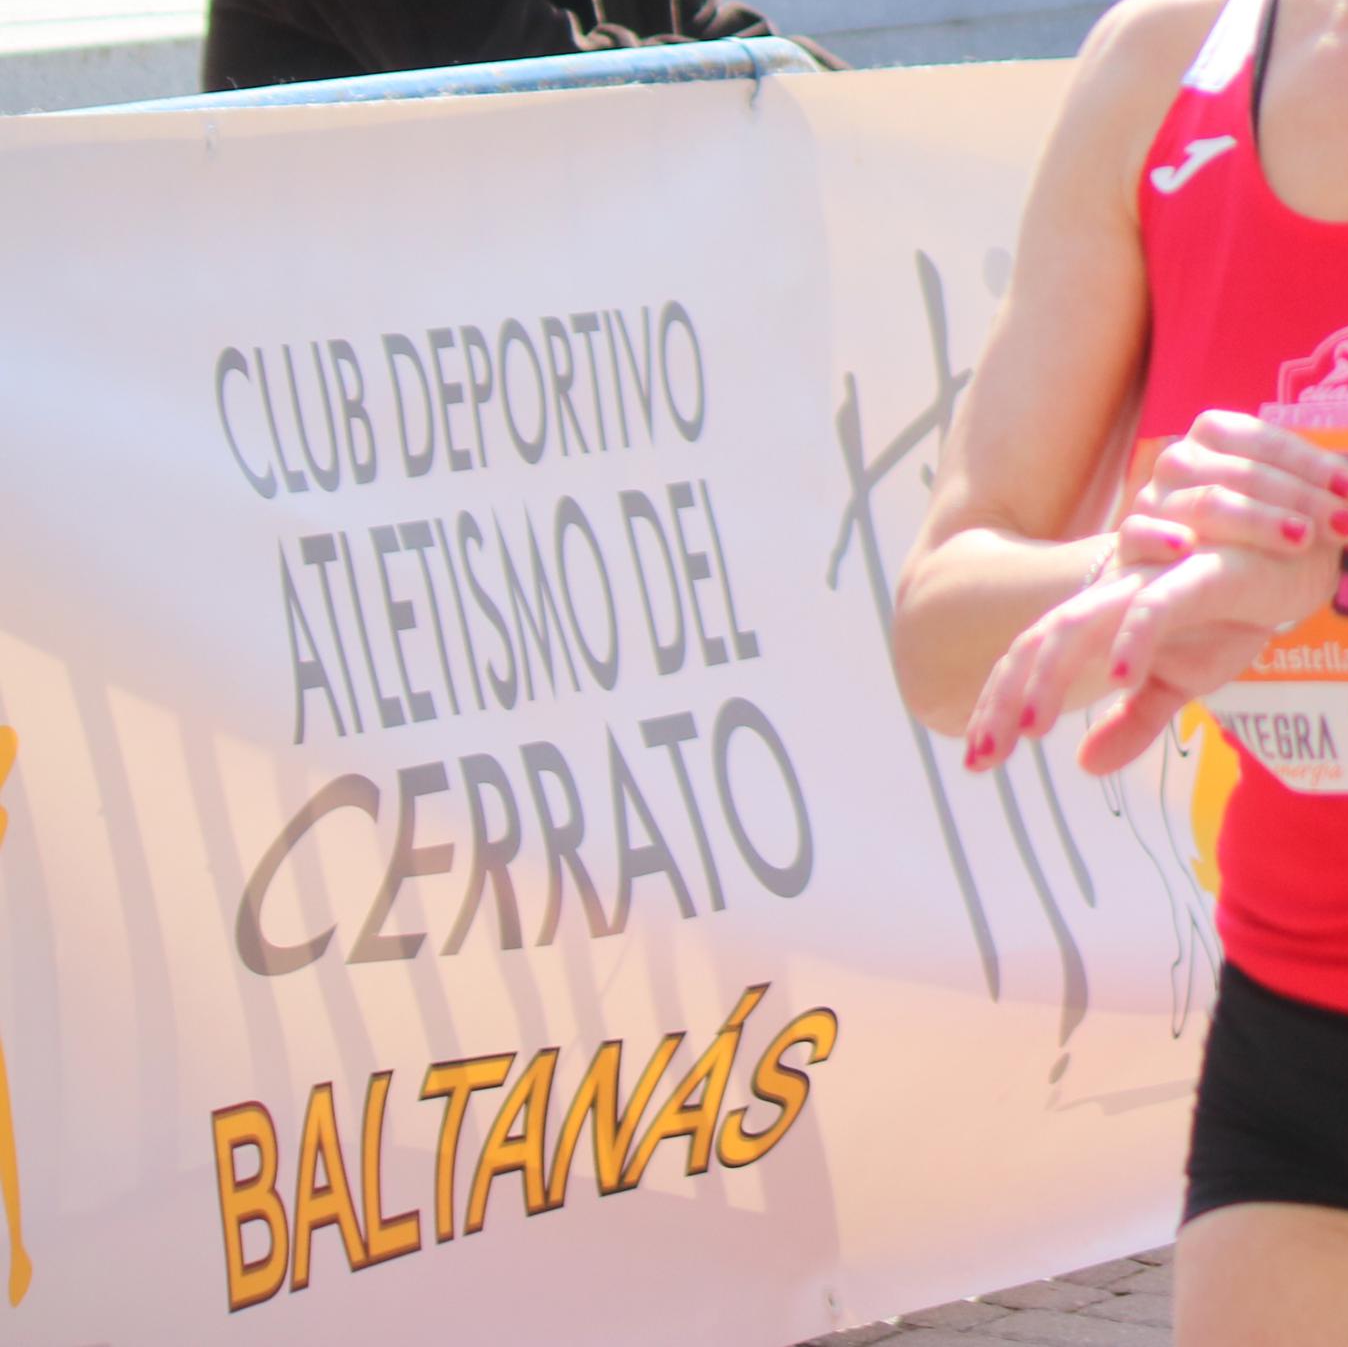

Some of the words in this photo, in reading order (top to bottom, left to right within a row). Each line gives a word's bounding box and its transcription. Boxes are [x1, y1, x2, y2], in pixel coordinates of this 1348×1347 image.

[213, 337, 379, 501] CLUB
[381, 299, 707, 479] DEPORTIVO
[276, 494, 621, 746] ATLETISMO
[617, 477, 761, 678] DEL
[234, 694, 814, 978] CERRATO
[210, 981, 839, 1314] BALTANÁS
